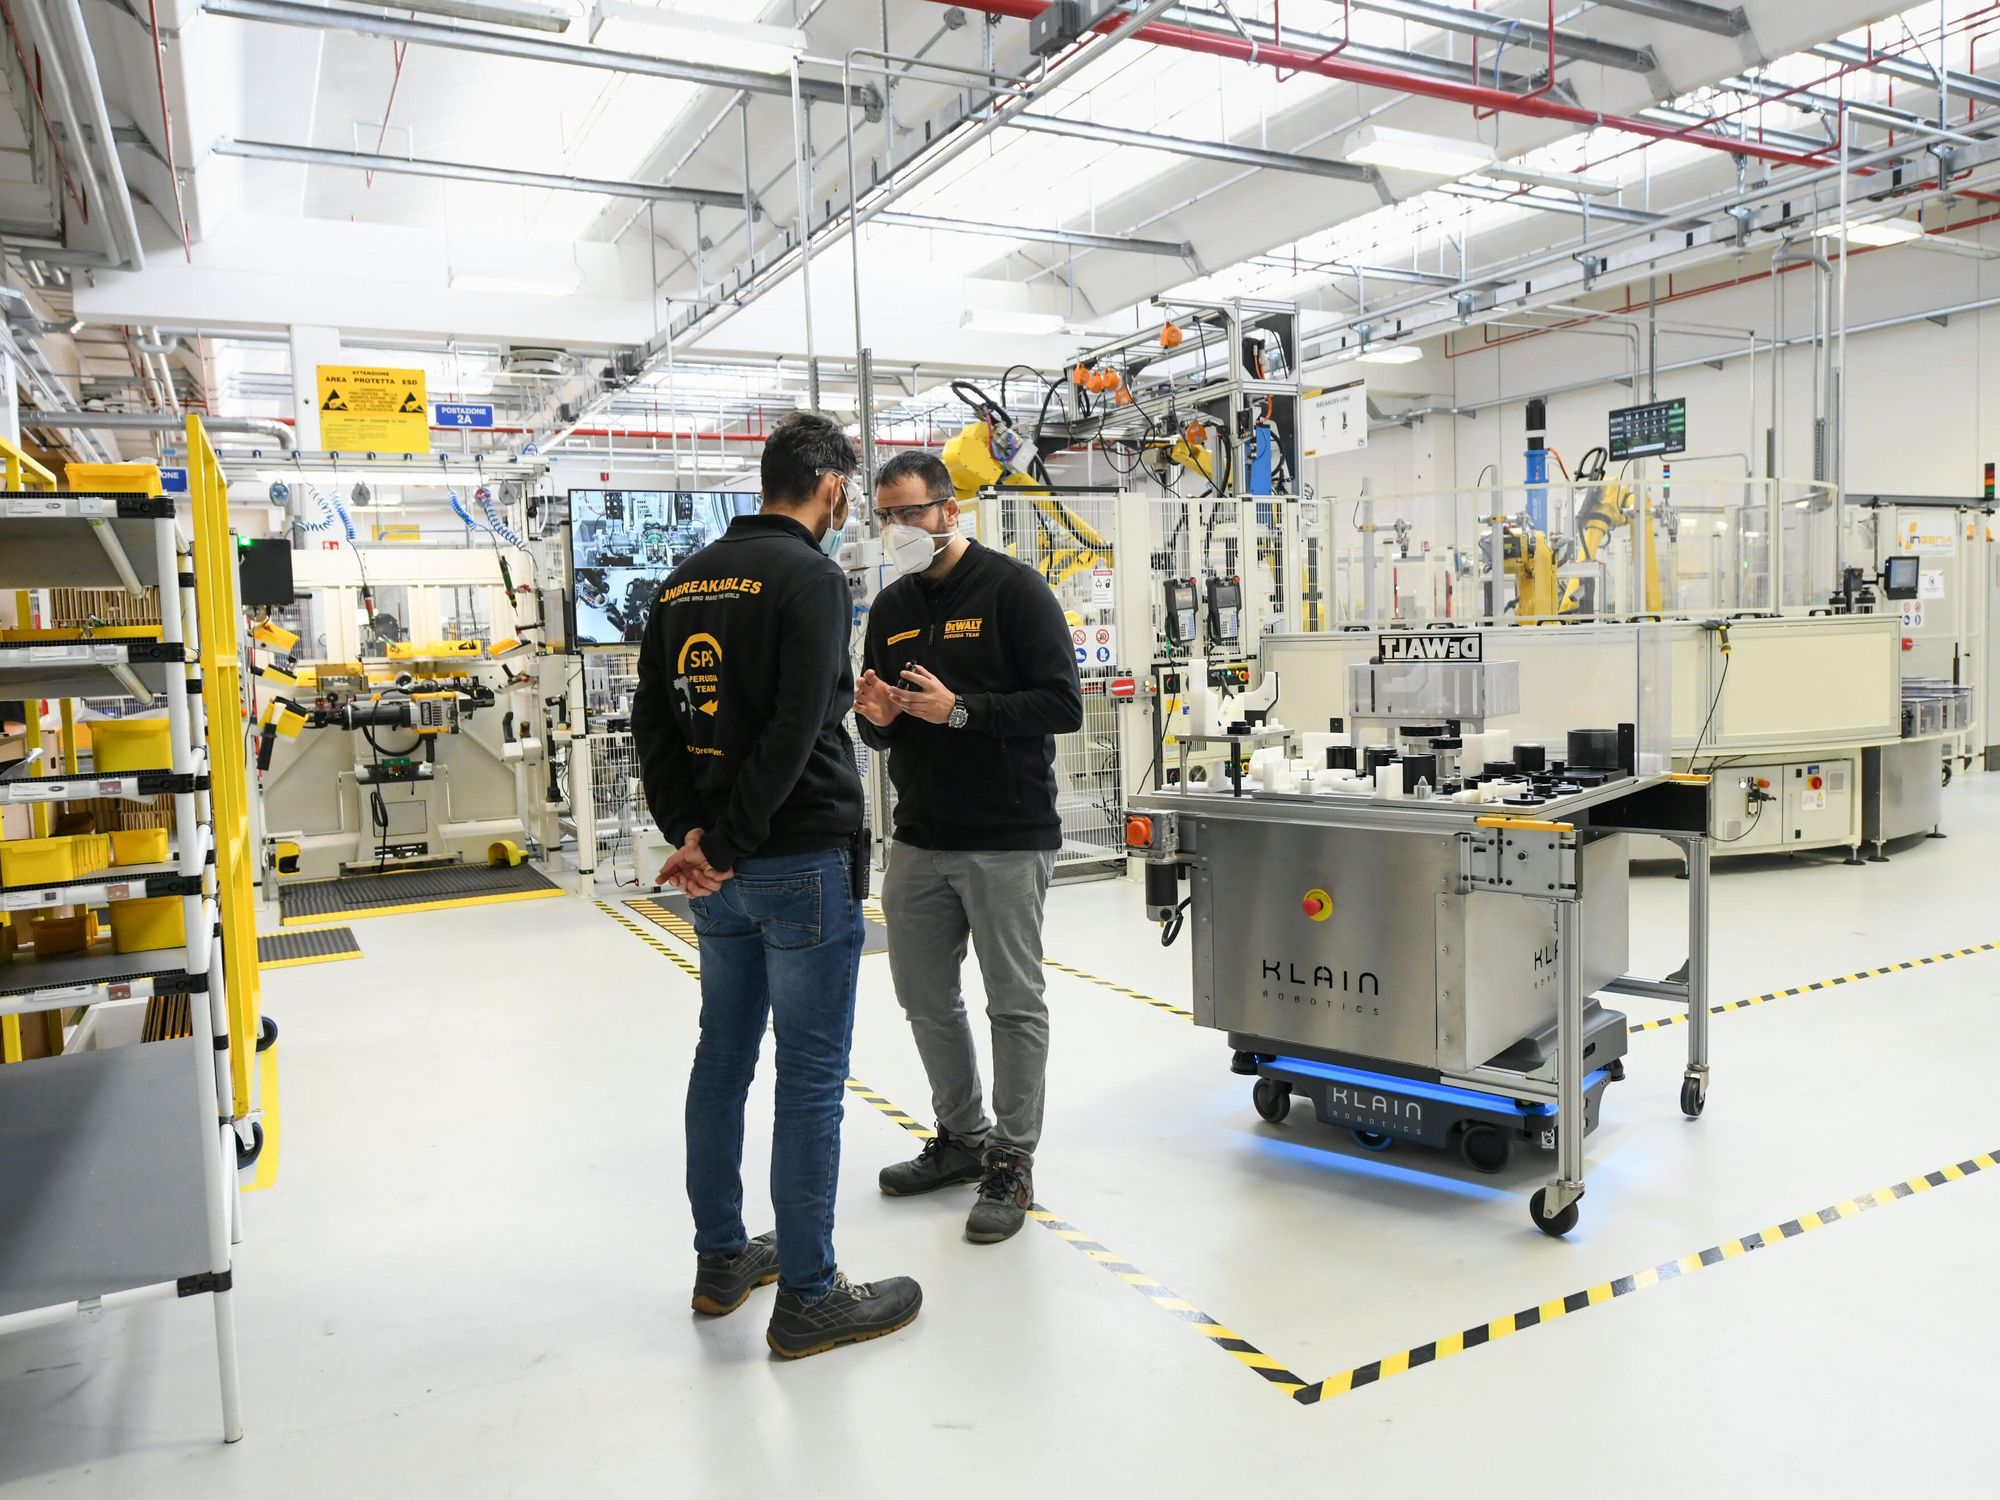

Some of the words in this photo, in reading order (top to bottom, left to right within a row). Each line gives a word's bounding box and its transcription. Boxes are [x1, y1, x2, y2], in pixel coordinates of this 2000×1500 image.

[441, 406, 487, 415] POSTAZIONE
[457, 414, 472, 424] 2A
[160, 471, 179, 479] ONE
[695, 685, 716, 693] TEAM
[1262, 990, 1380, 1016] ROBOTICS
[1332, 1110, 1422, 1135] ROBOTICS
